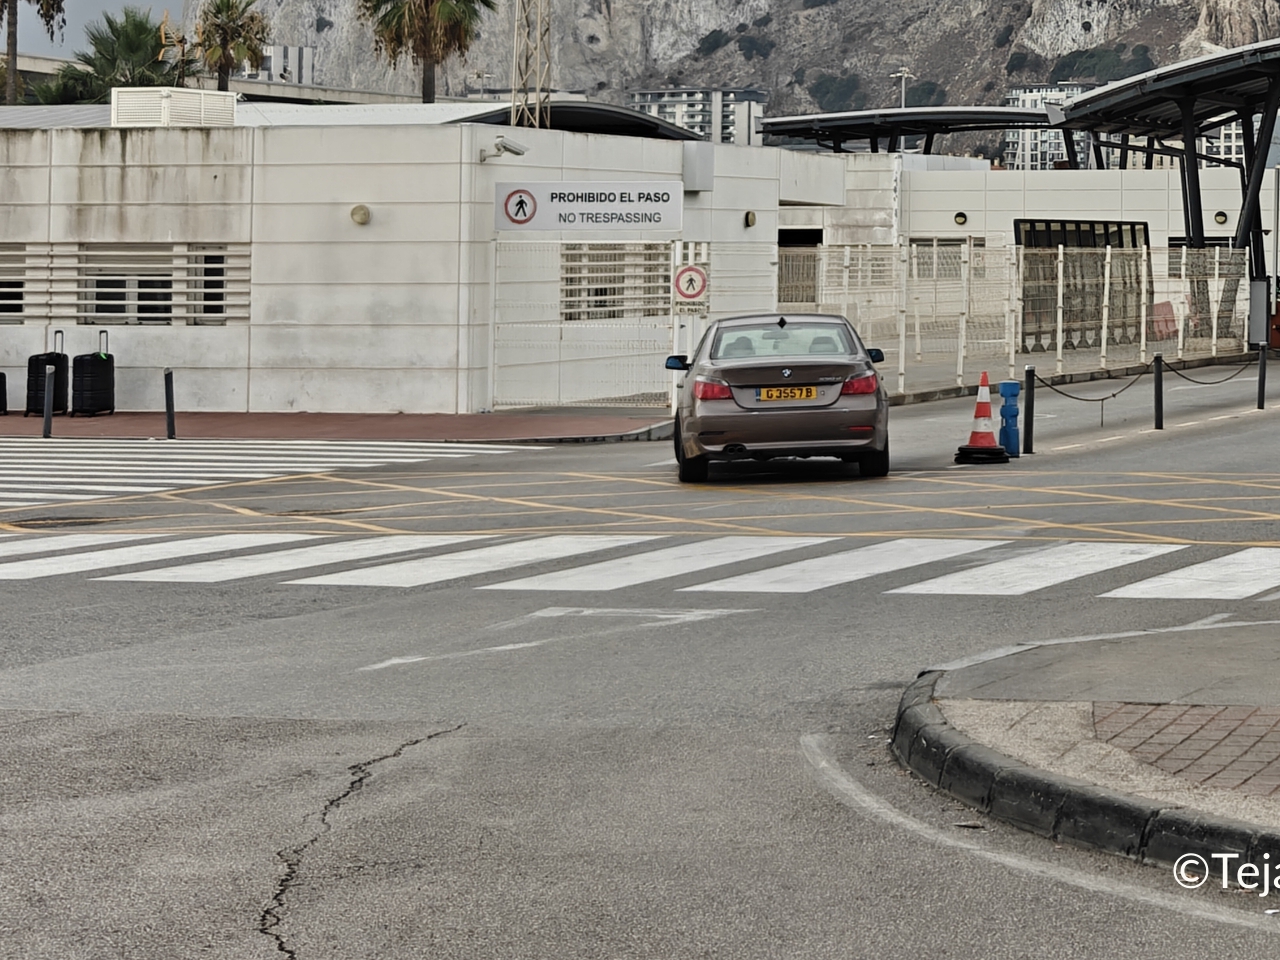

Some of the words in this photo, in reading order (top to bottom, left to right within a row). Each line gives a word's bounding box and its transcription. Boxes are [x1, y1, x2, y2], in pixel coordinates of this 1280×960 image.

[550, 192, 616, 203] PROHIBIDO
[620, 191, 635, 203] EL
[638, 191, 671, 203] PASO
[558, 212, 576, 224] NO
[579, 211, 662, 224] TRESPASSING
